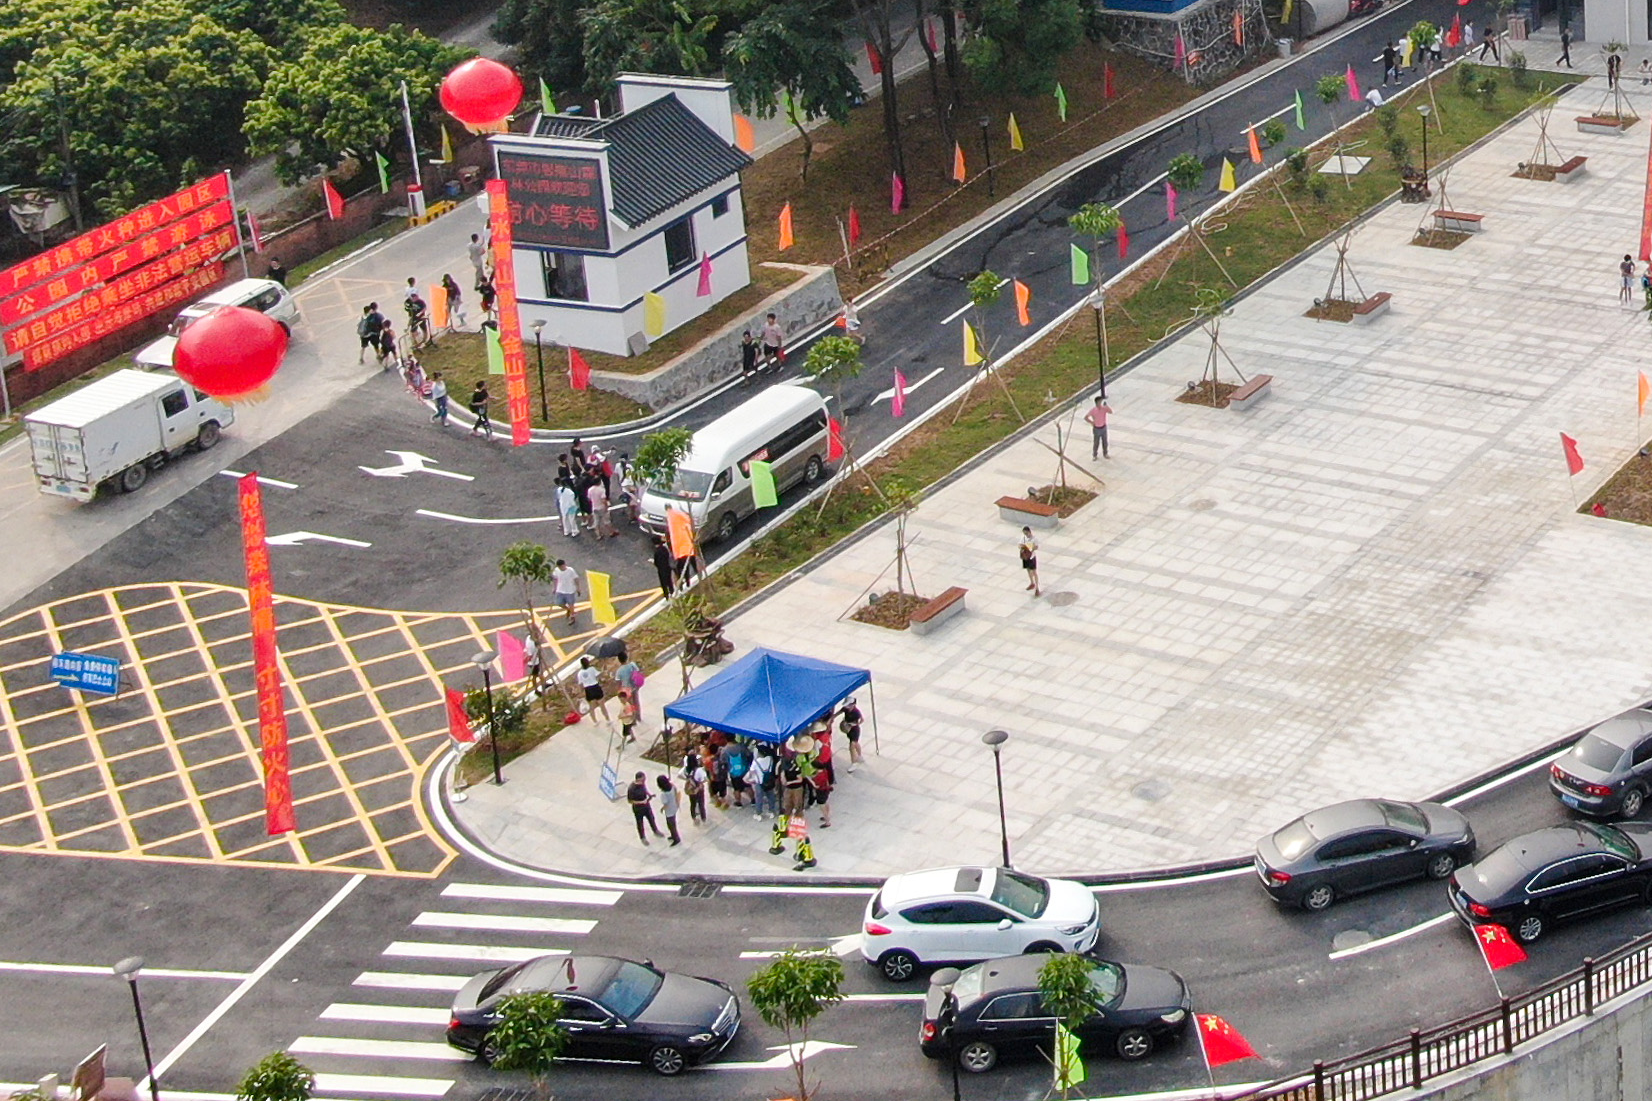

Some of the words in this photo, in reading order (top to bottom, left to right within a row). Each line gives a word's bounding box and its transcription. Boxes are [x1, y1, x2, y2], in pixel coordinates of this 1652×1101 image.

[11, 183, 214, 289] 严禁携带火种进入园区
[16, 210, 217, 315] 公园内严禁游泳
[11, 231, 234, 349] 请自觉拒绝乘坐非法营运车辆
